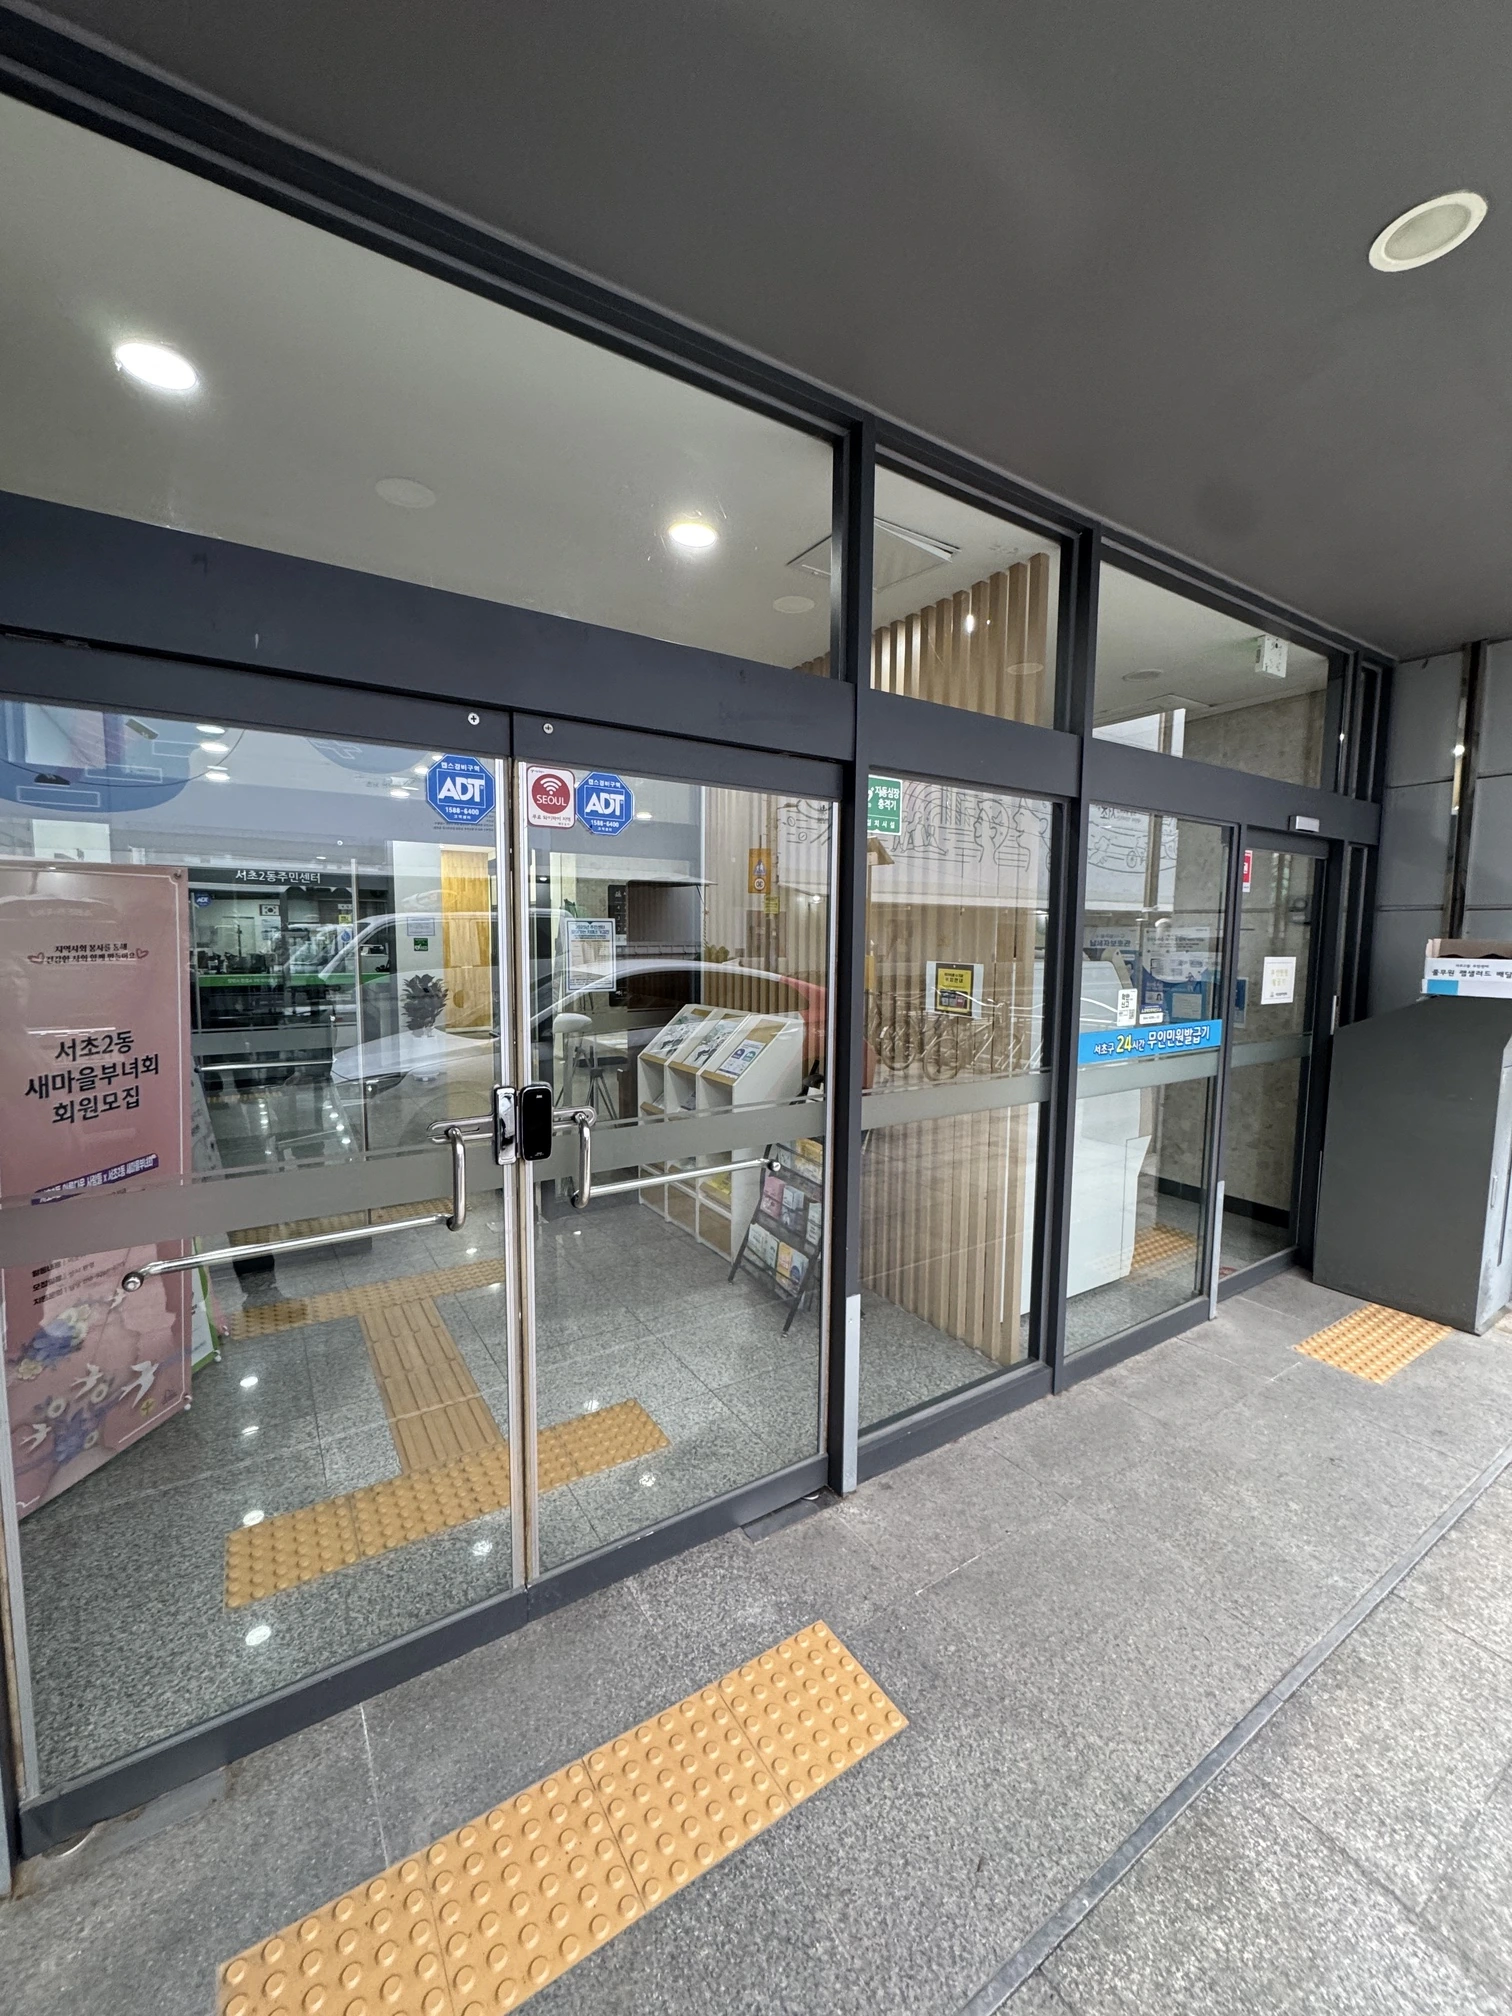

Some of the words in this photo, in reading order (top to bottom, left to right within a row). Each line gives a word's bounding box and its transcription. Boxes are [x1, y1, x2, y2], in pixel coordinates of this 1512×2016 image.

[441, 762, 480, 772] 캡스경비구역
[438, 776, 485, 802] ADT
[588, 779, 620, 788] 캡스경비구역
[875, 786, 899, 799] 자동심장
[536, 794, 567, 806] SEOUL
[585, 792, 624, 816] ADT
[878, 799, 897, 811] 충격기
[445, 806, 479, 815] 1588-6400
[591, 819, 619, 828] 1588-6400
[235, 870, 321, 884] 서초2동주민센터
[55, 944, 87, 953] 지역사회
[89, 944, 111, 952] 봉사를
[55, 1030, 134, 1062] 서초2동
[1094, 1042, 1114, 1055] 서초구
[1116, 1034, 1145, 1052] 24시간
[1147, 1026, 1210, 1049] 무인민원발급기
[25, 1054, 159, 1099] 새마을부녀회
[52, 1085, 140, 1123] 회원모집
